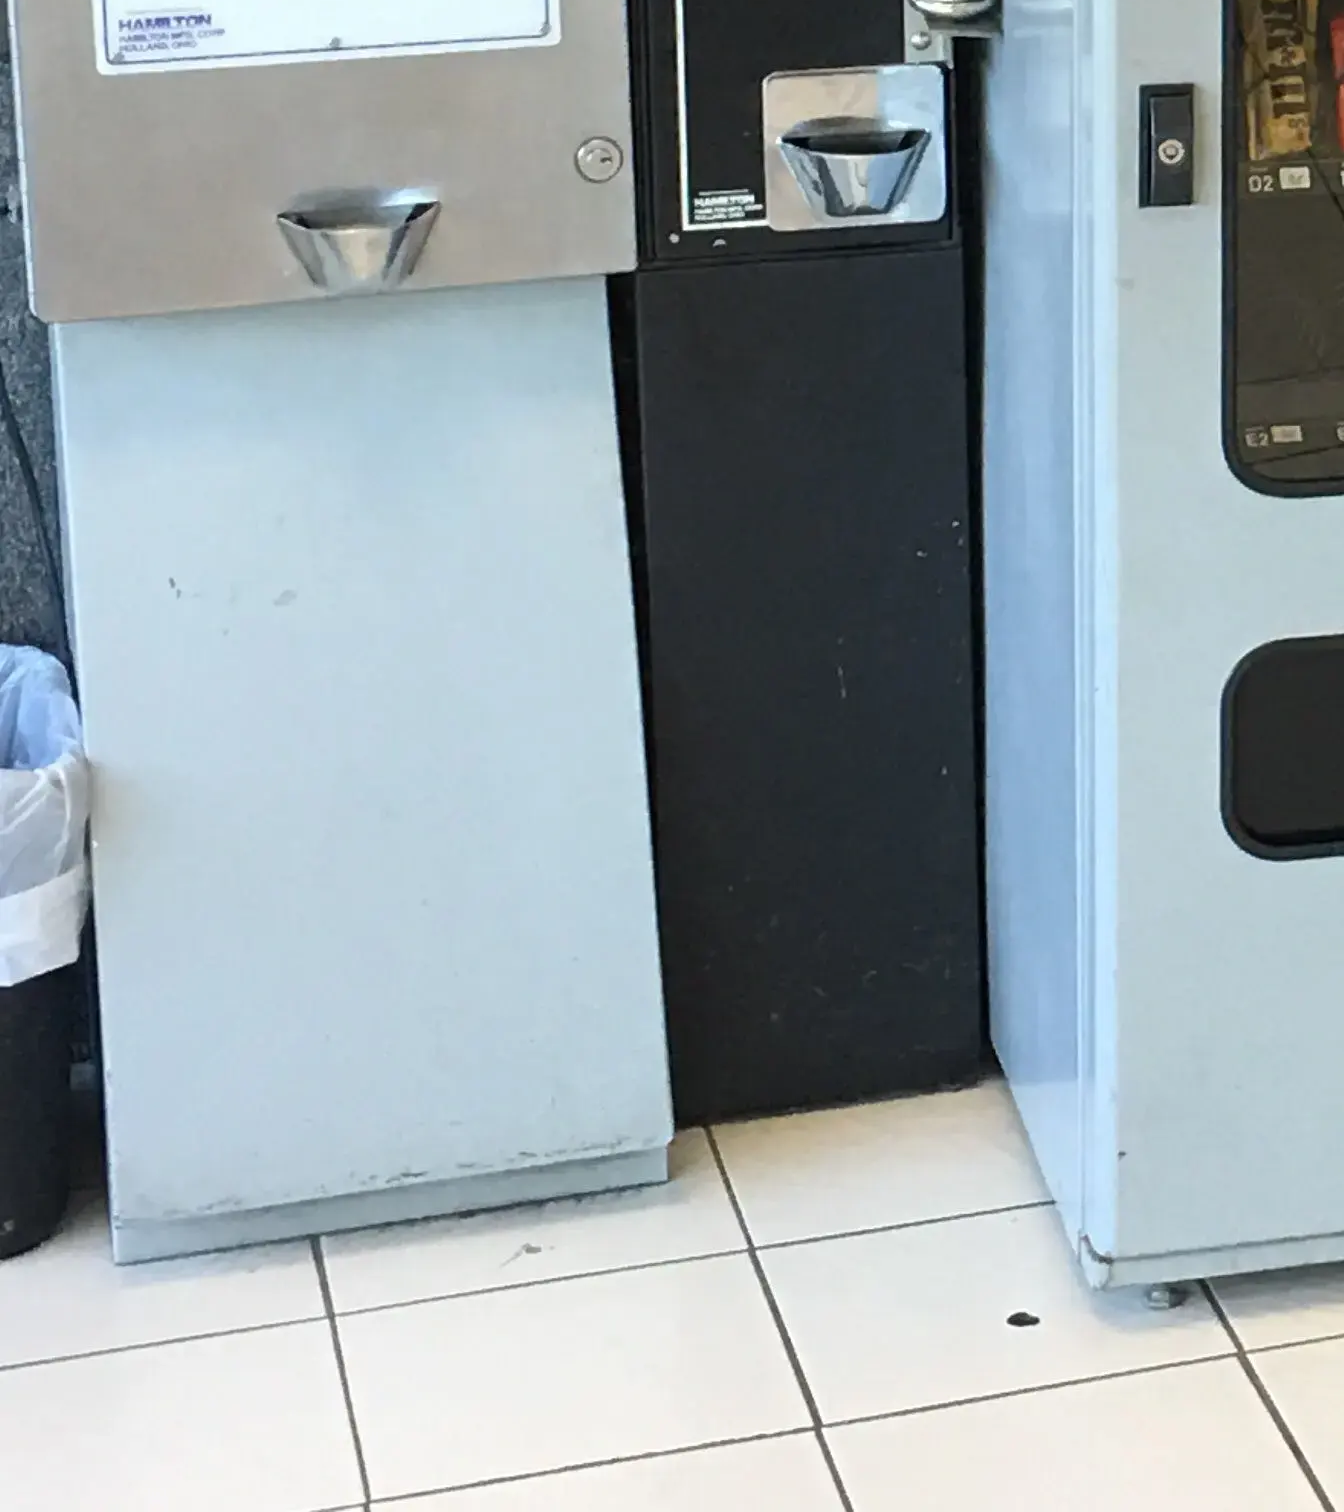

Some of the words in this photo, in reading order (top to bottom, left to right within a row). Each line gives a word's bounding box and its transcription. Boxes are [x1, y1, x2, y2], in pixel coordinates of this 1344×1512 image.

[118, 13, 212, 32] HAMILTON
[1248, 175, 1274, 193] D2
[1245, 431, 1269, 448] E2
